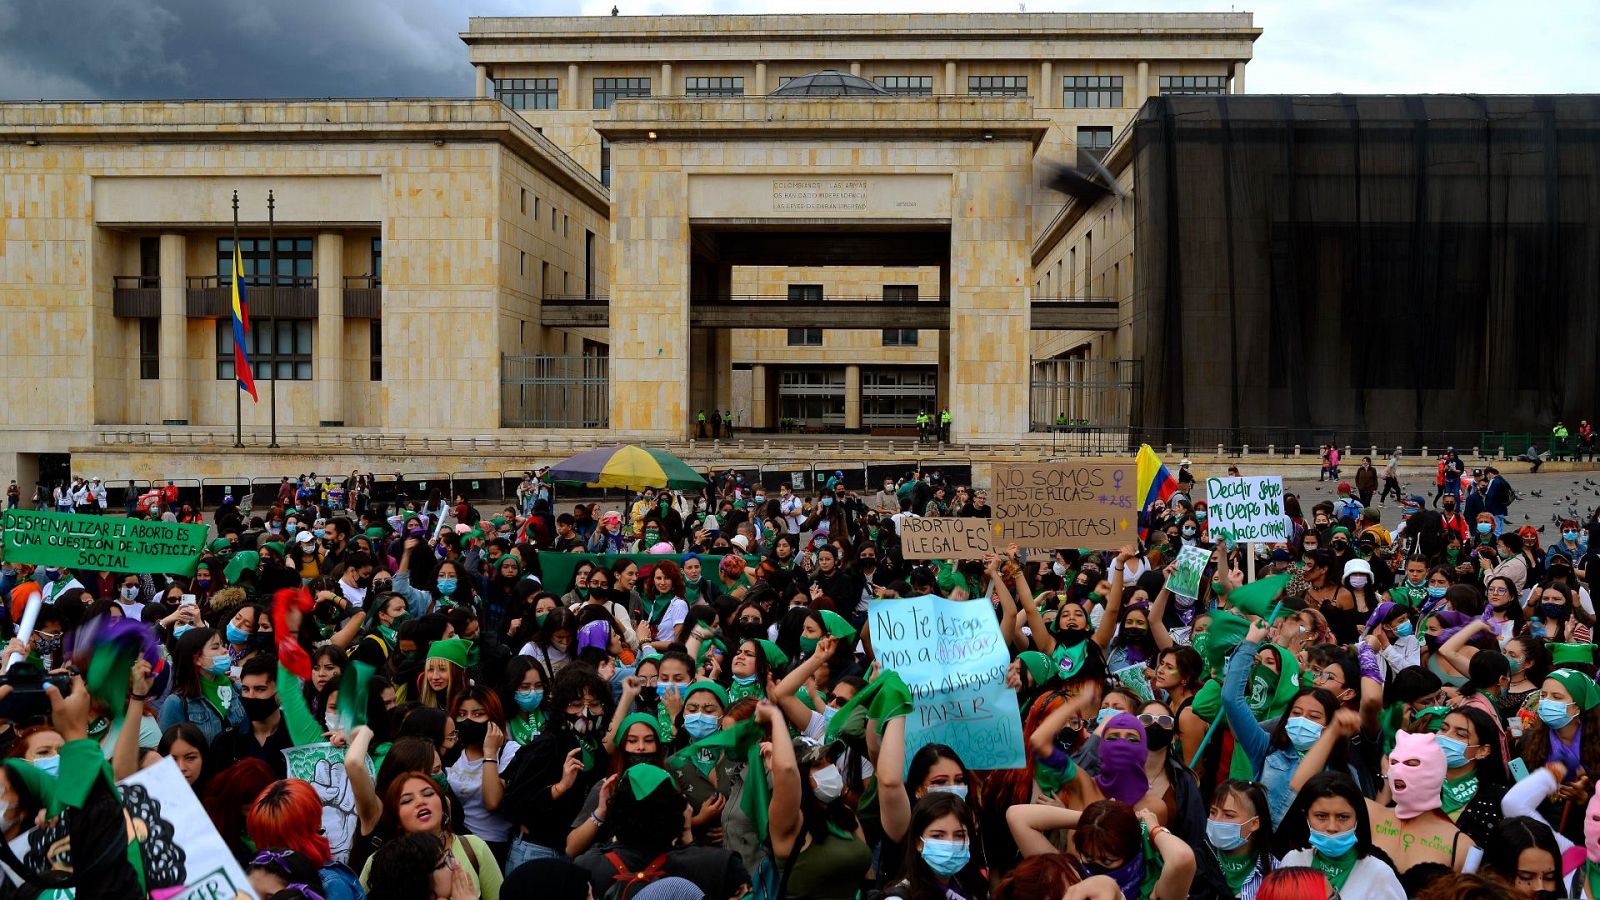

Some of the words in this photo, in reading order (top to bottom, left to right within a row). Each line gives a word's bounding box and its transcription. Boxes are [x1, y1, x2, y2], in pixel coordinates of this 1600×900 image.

[996, 468, 1025, 488] NO
[1032, 467, 1104, 488] SOMOS
[996, 485, 1095, 502] HISTERICAS
[1208, 477, 1251, 501] Decidir
[1098, 495, 1132, 509] #285
[5, 514, 110, 537] DESPENALIZAR
[113, 523, 126, 538] EL
[130, 524, 174, 540] ABORTO
[177, 527, 190, 541] ES
[902, 518, 964, 533] ABORTO
[1003, 517, 1117, 540] HISTORICAS!
[1233, 522, 1260, 541] hace
[14, 532, 42, 546] UNA
[118, 541, 134, 553] DE
[138, 542, 197, 556] JUSTICIA
[906, 536, 962, 554] ILEGAL
[966, 528, 989, 552] ES
[77, 551, 129, 568] SOCIAL
[877, 610, 905, 641] No
